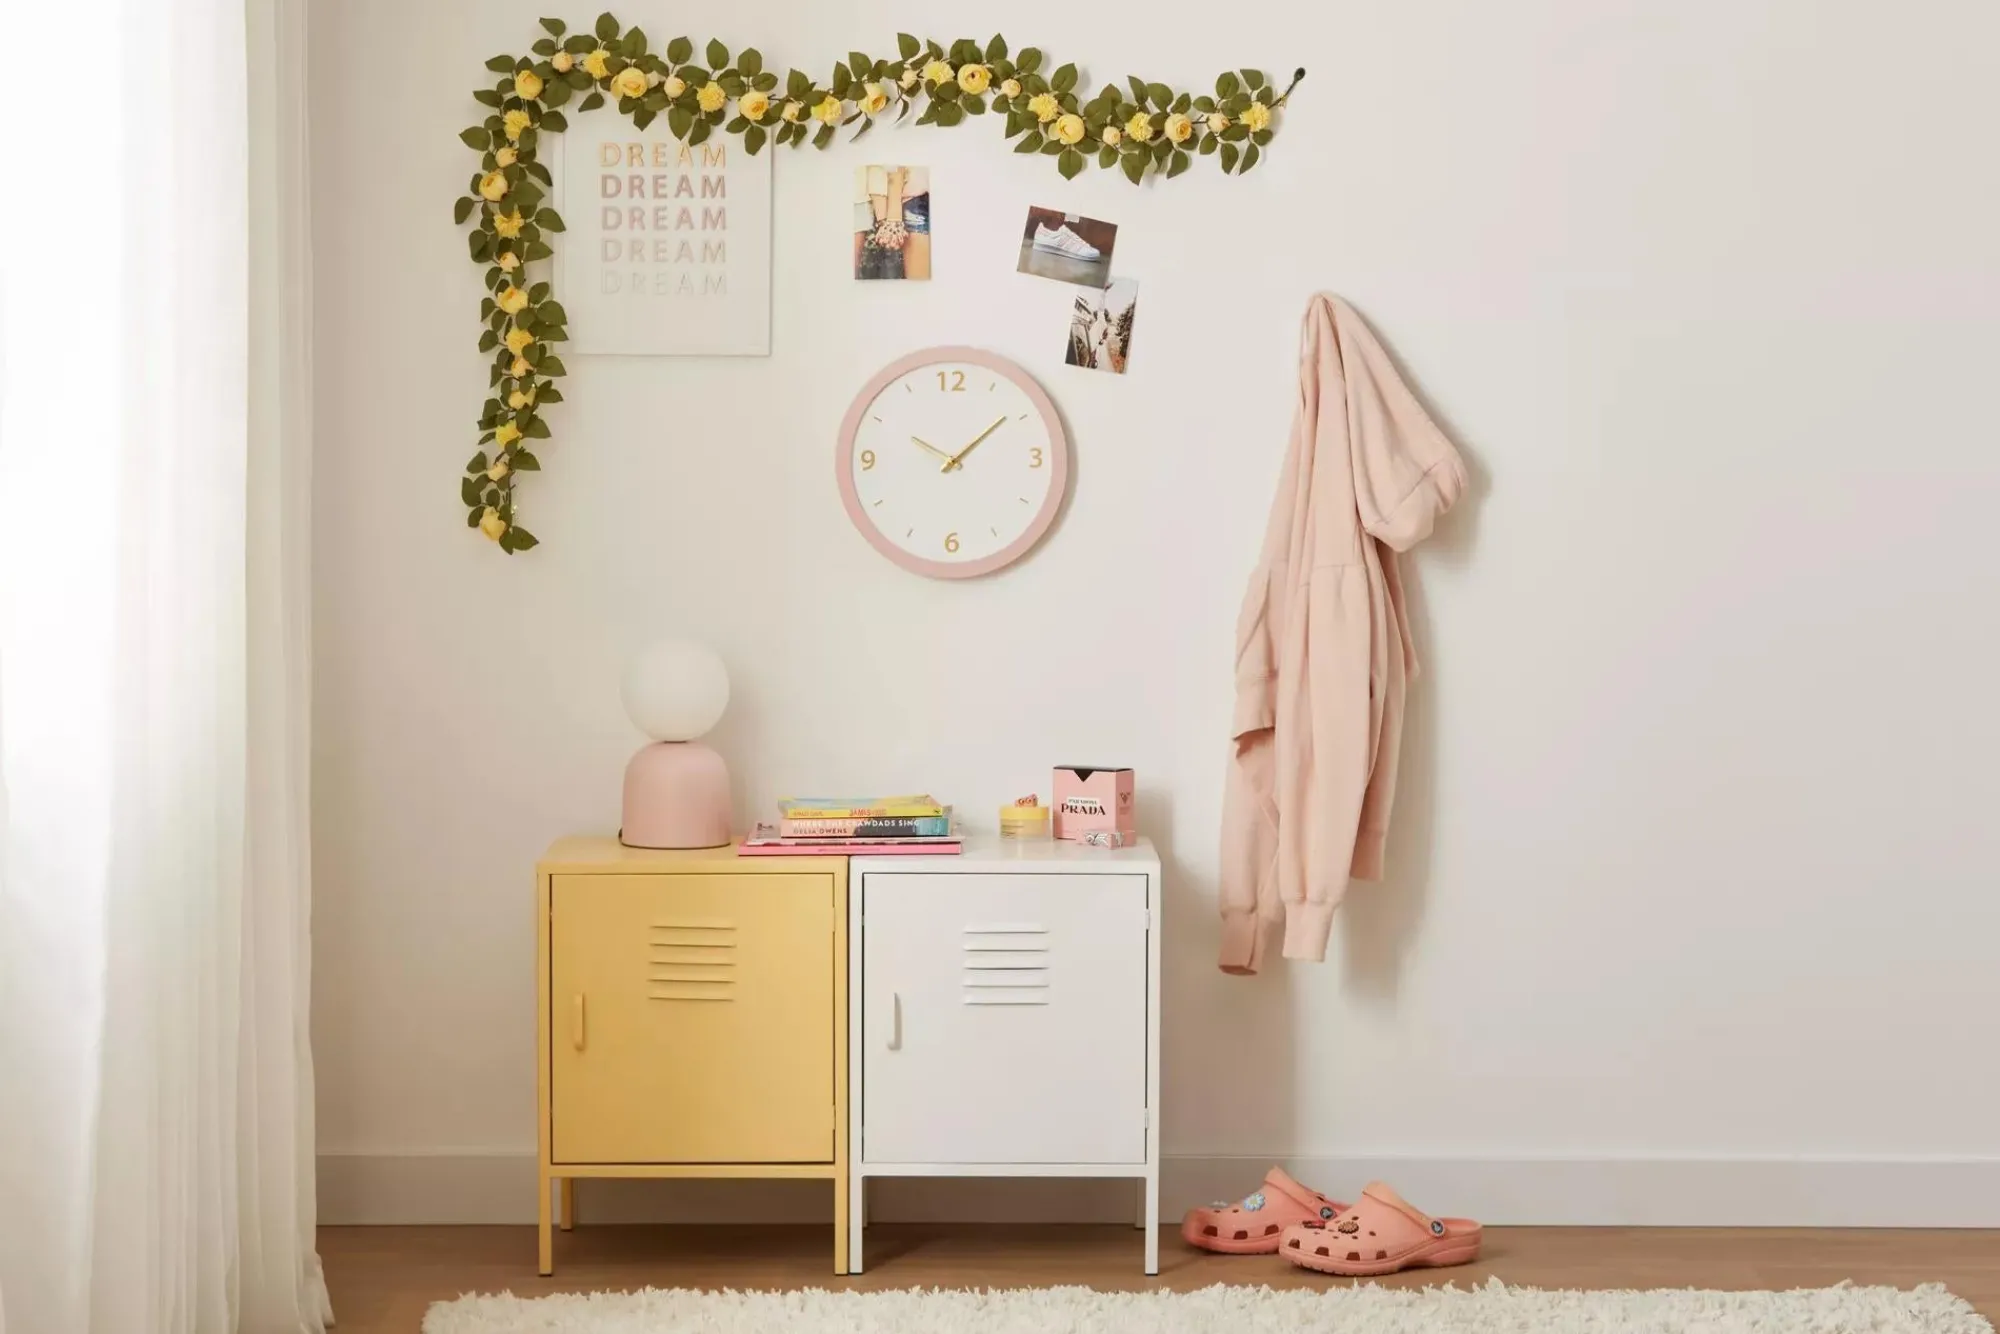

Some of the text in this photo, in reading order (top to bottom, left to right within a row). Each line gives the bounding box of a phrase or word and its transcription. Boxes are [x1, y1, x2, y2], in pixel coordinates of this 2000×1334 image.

[600, 142, 726, 168] DREAM
[601, 174, 726, 199] DREAM
[601, 206, 727, 231] DREAM
[601, 238, 727, 264] DREAM
[601, 270, 727, 296] DREAM
[937, 371, 966, 392] 12
[861, 450, 876, 471] 9
[1029, 448, 1043, 468] 3
[944, 532, 960, 553] 6
[1061, 803, 1106, 815] PRADA
